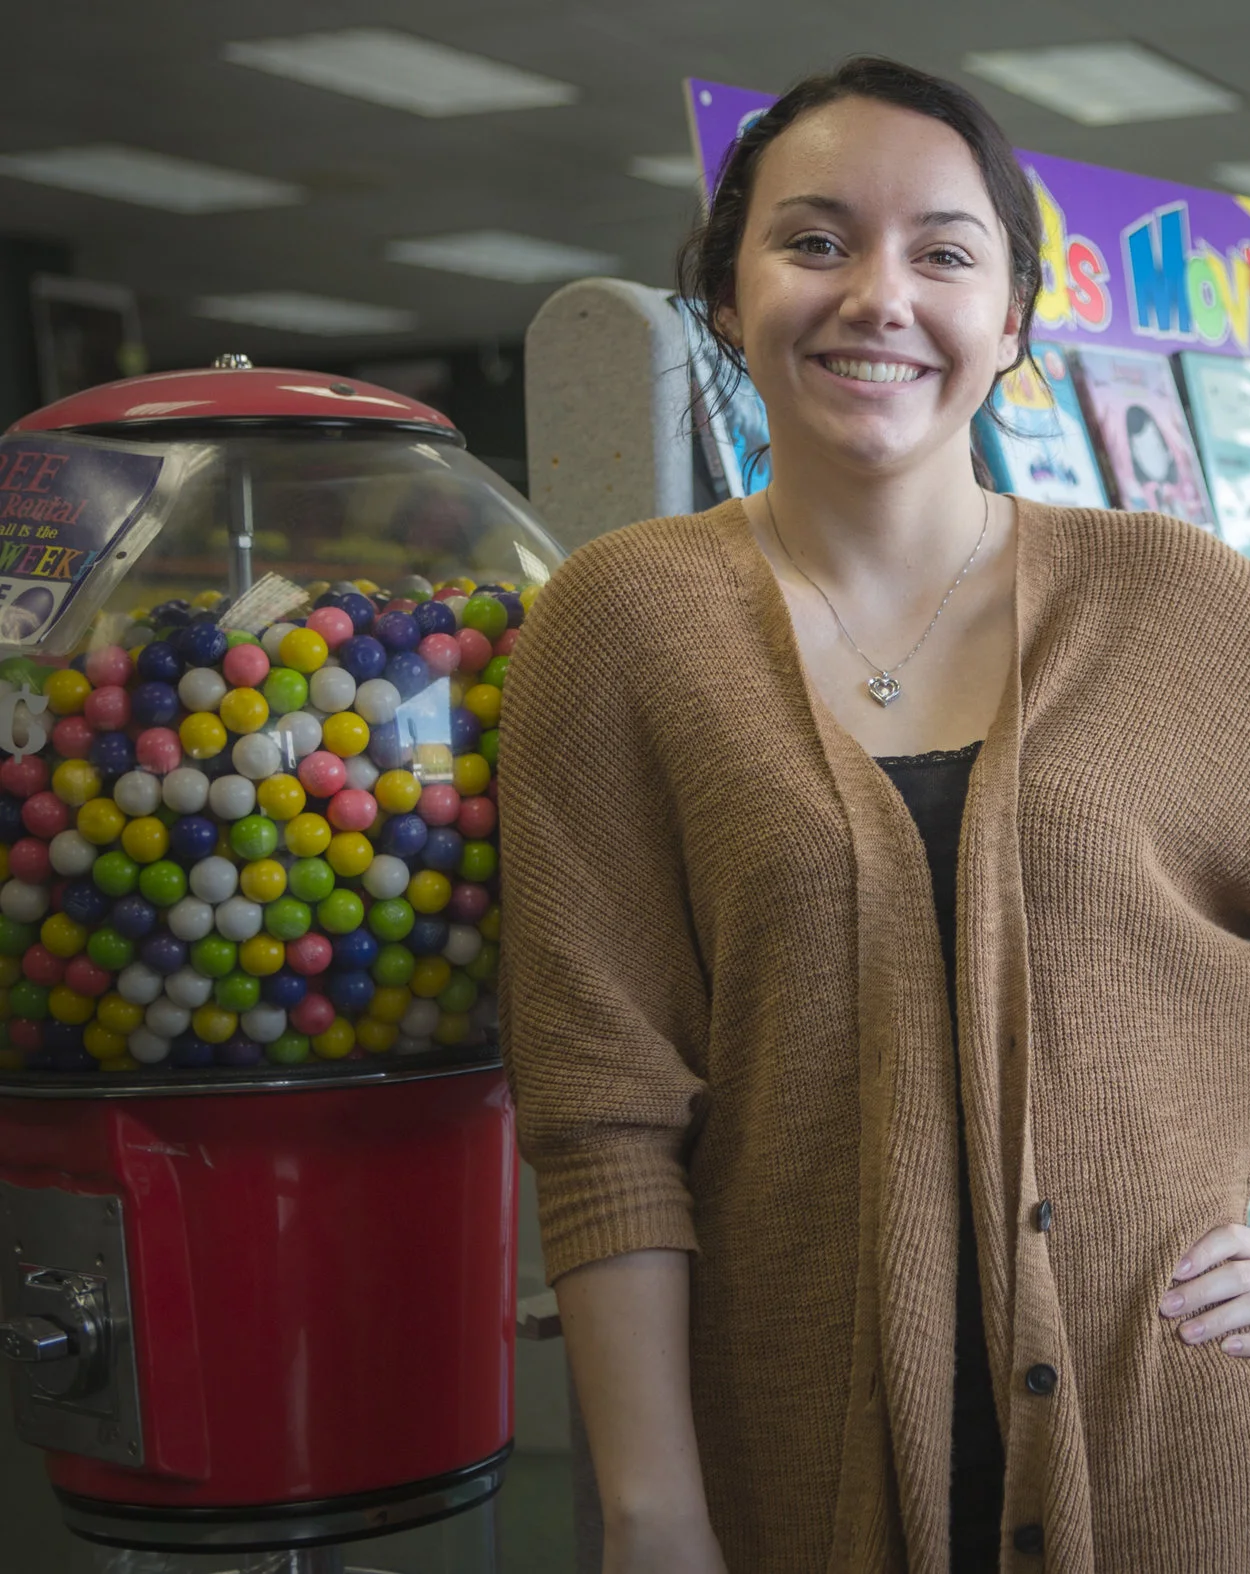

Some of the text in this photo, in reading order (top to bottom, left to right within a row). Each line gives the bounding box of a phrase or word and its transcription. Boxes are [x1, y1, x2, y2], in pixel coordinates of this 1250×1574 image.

[0, 452, 69, 493] EE
[0, 494, 87, 525] Rental
[36, 524, 59, 539] the
